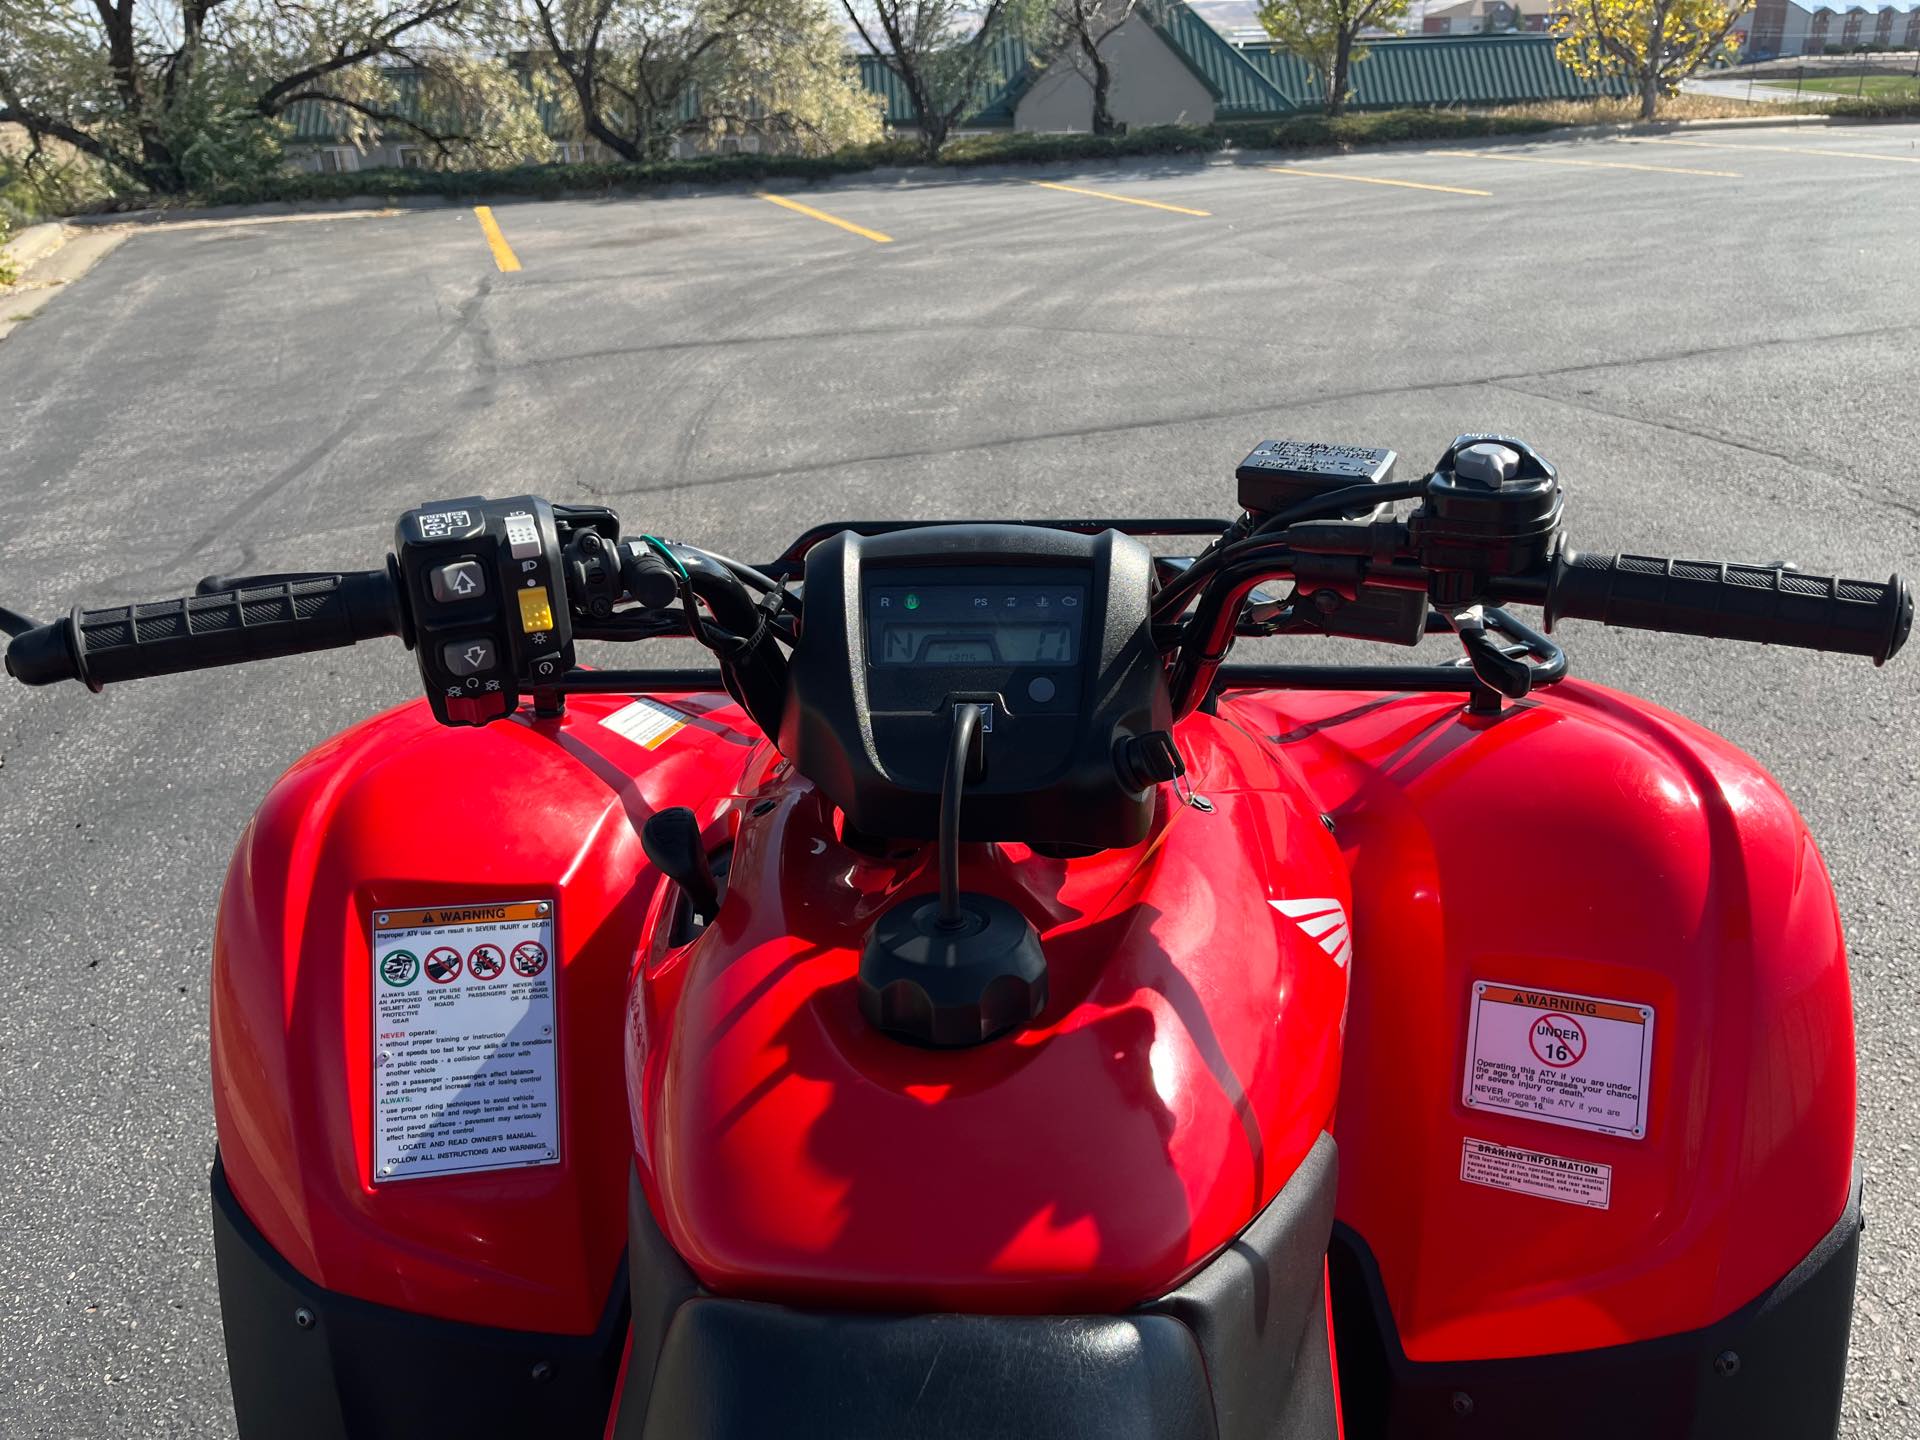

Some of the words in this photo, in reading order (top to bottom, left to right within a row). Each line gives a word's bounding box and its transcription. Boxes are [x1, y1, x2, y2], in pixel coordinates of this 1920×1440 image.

[880, 598, 889, 607] R
[974, 598, 988, 607] PS
[887, 631, 913, 658] N
[440, 908, 505, 922] WARNING
[377, 931, 403, 939] Improper
[1526, 994, 1597, 1014] WARNING
[408, 1029, 436, 1037] operate:
[436, 1036, 459, 1044] training
[1536, 1025, 1579, 1040] UNDER
[406, 1049, 427, 1057] speeds
[1544, 1043, 1567, 1061] 16
[397, 1060, 416, 1068] public
[453, 1054, 479, 1062] collision
[410, 1078, 442, 1086] passenger
[451, 1073, 486, 1082] passengers
[1476, 1058, 1515, 1072] Operating
[1520, 1066, 1535, 1074] this
[1539, 1069, 1556, 1078] ATV
[1570, 1076, 1585, 1085] you
[1590, 1079, 1604, 1087] are
[1606, 1080, 1631, 1091] under
[1476, 1065, 1488, 1073] the
[1492, 1070, 1507, 1078] age
[1511, 1071, 1519, 1079] of
[1538, 1076, 1577, 1089] increases
[1582, 1085, 1601, 1095] your
[1606, 1088, 1637, 1100] chance
[401, 1086, 426, 1095] steering
[498, 1077, 516, 1085] losing
[1488, 1076, 1514, 1085] severe
[1518, 1080, 1541, 1091] injury
[1559, 1087, 1584, 1098] death.
[380, 1096, 412, 1104] ALWAYS:
[425, 1103, 443, 1111] riding
[446, 1099, 480, 1109] techniques
[1474, 1084, 1503, 1095] NEVER
[1507, 1090, 1536, 1102] operate
[1540, 1096, 1554, 1104] this
[1558, 1099, 1574, 1108] ATV
[1587, 1105, 1602, 1115] you
[1488, 1093, 1510, 1103] under
[1514, 1099, 1528, 1108] age
[1533, 1102, 1544, 1110] 16.
[462, 1107, 480, 1116] rough
[406, 1124, 425, 1132] paved
[429, 1120, 455, 1128] surfaces
[464, 1116, 494, 1126] pavement
[514, 1112, 541, 1121] seriously
[398, 1142, 425, 1151] LOCATE
[448, 1138, 467, 1146] READ
[471, 1134, 502, 1143] OWNER'S
[407, 1131, 434, 1140] handling
[387, 1156, 417, 1165] FOLLOW
[437, 1148, 488, 1159] INSTRUCTIONS
[1477, 1144, 1523, 1160] BRAKING
[1527, 1154, 1598, 1175] INFORMATION
